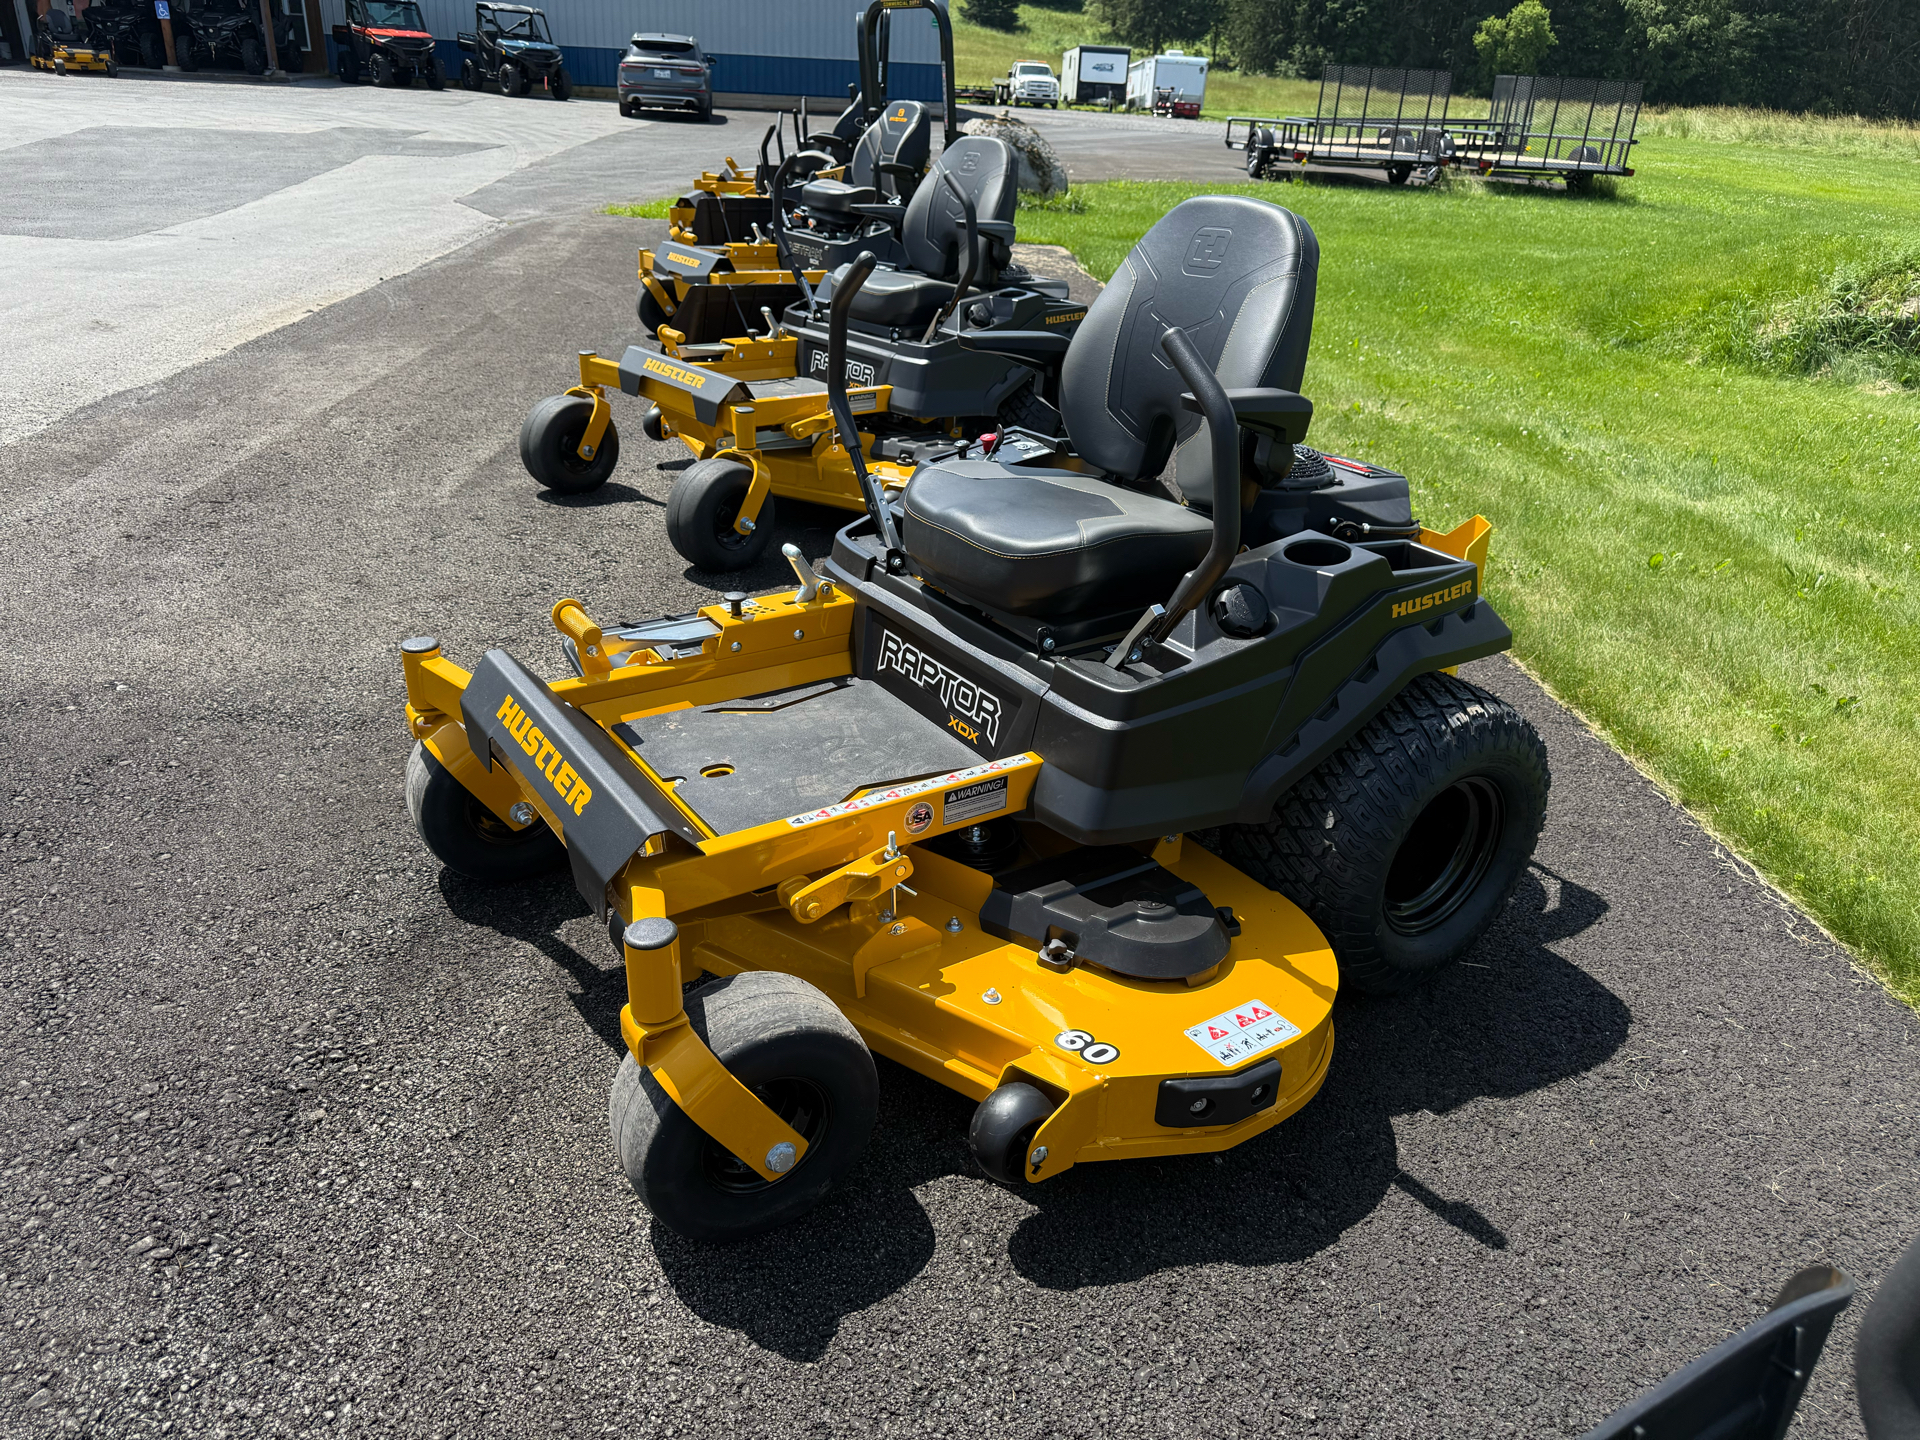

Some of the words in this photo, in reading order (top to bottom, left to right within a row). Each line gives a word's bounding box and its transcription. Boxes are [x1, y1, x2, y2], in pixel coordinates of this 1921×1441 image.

[667, 251, 701, 269] HUSTLER
[1045, 311, 1086, 325] HUSTLER
[642, 357, 706, 389] HUSTLER
[1391, 579, 1473, 619] HUSTLER
[877, 629, 1002, 748] RAPTOR
[947, 714, 980, 745] XDX
[496, 694, 592, 816] HUSTLER
[957, 778, 1005, 800] WARNING!
[905, 811, 932, 826] USA
[1055, 1029, 1120, 1065] 60
